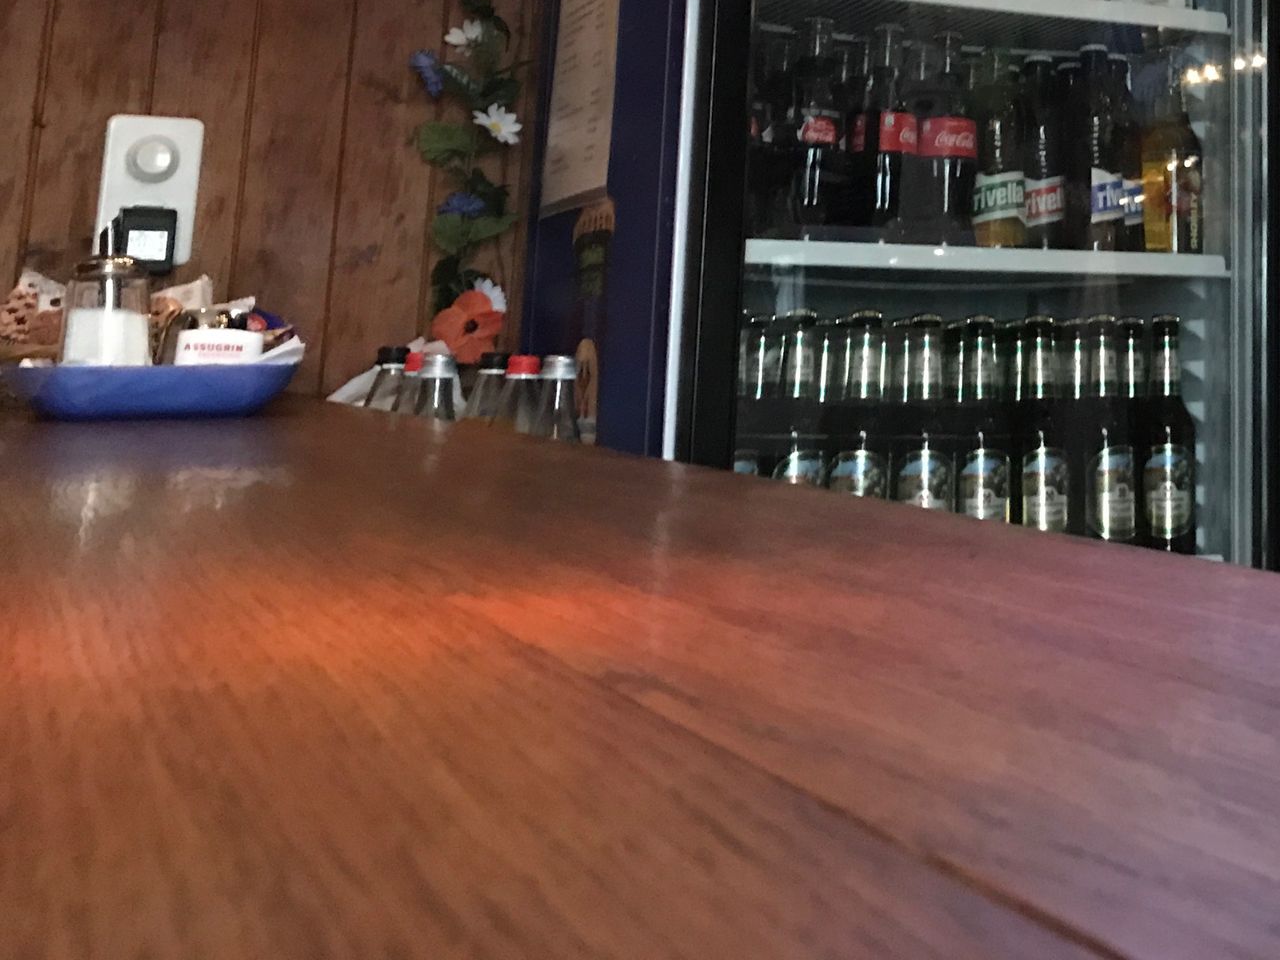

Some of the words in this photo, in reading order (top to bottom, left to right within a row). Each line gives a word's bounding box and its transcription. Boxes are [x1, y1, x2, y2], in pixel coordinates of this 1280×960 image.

[974, 181, 1025, 211] rivella
[1026, 189, 1061, 218] rivel
[184, 342, 244, 353] ASSUGRIN
